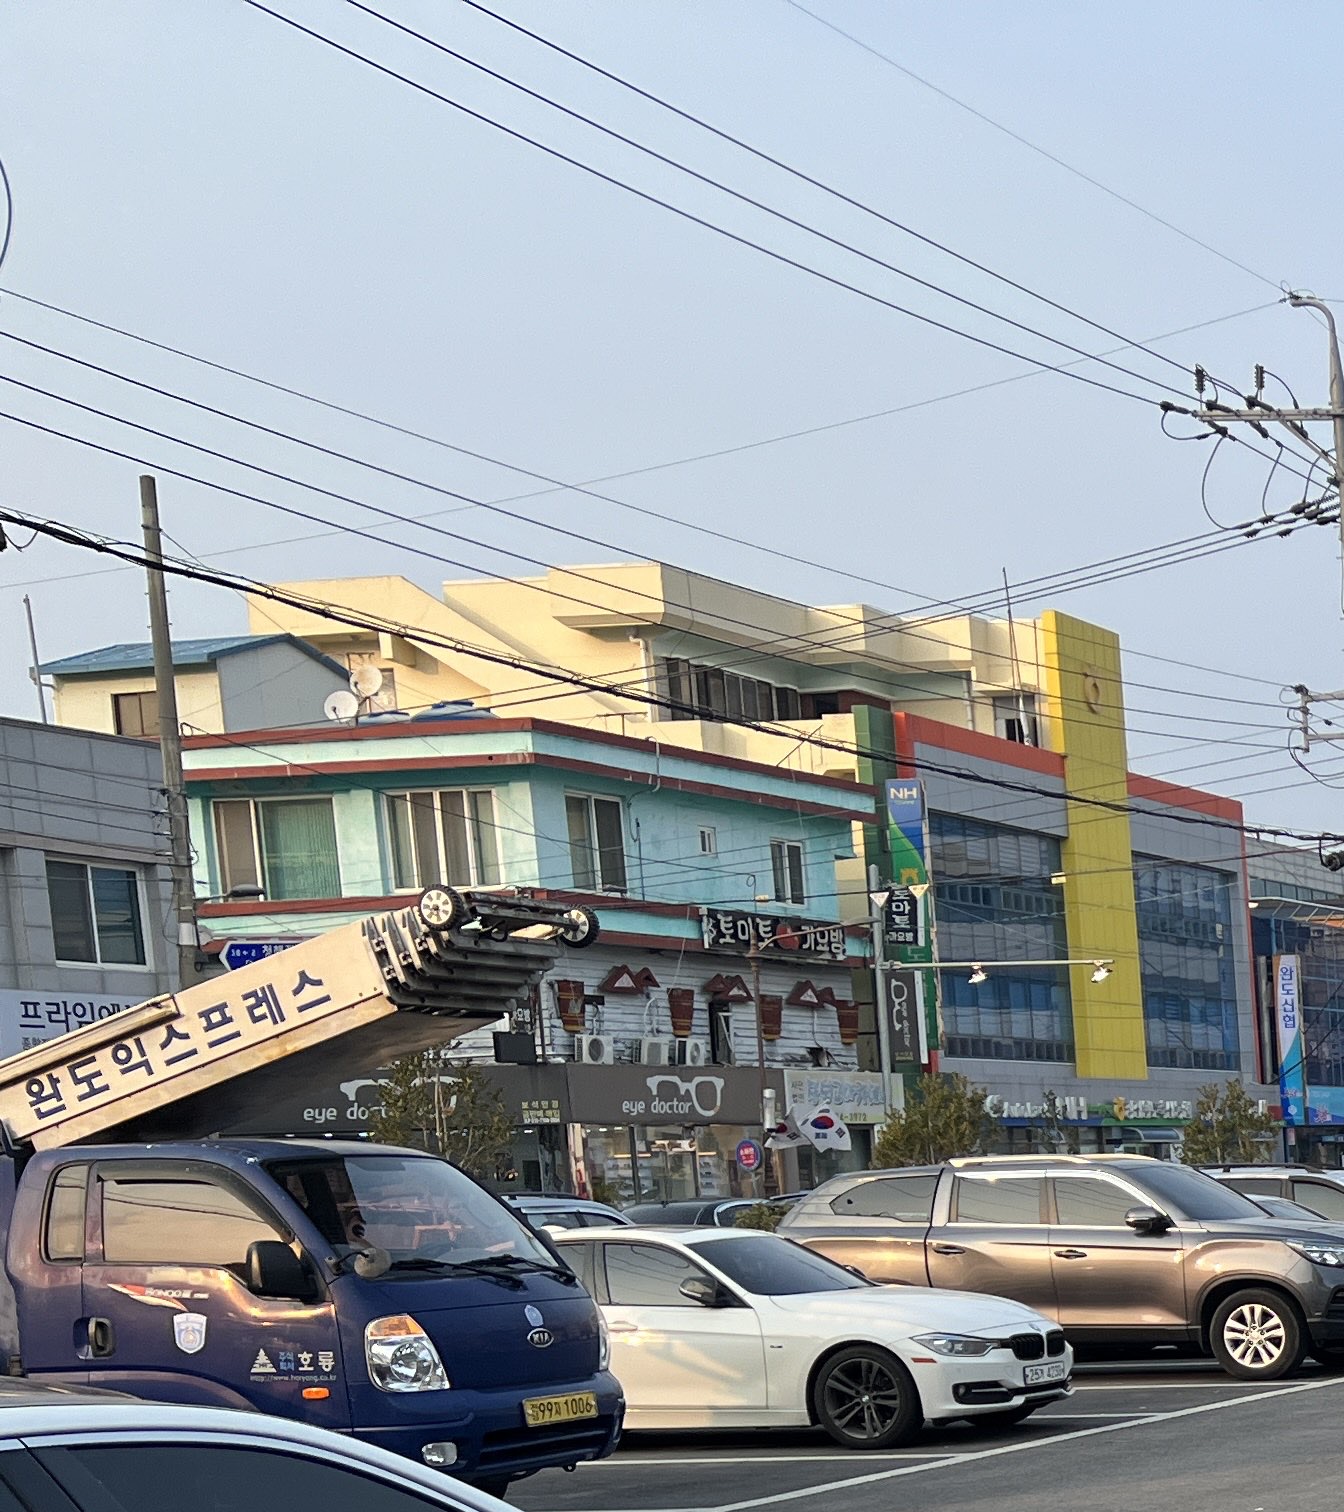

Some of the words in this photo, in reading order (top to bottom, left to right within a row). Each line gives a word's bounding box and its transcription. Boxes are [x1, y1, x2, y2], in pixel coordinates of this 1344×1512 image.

[890, 788, 917, 799] NH
[1279, 965, 1296, 1029] 완도신협
[25, 969, 332, 1121] 완도익스프레스
[303, 1107, 337, 1124] eye
[622, 1100, 646, 1116] eye
[651, 1098, 693, 1114] doctor
